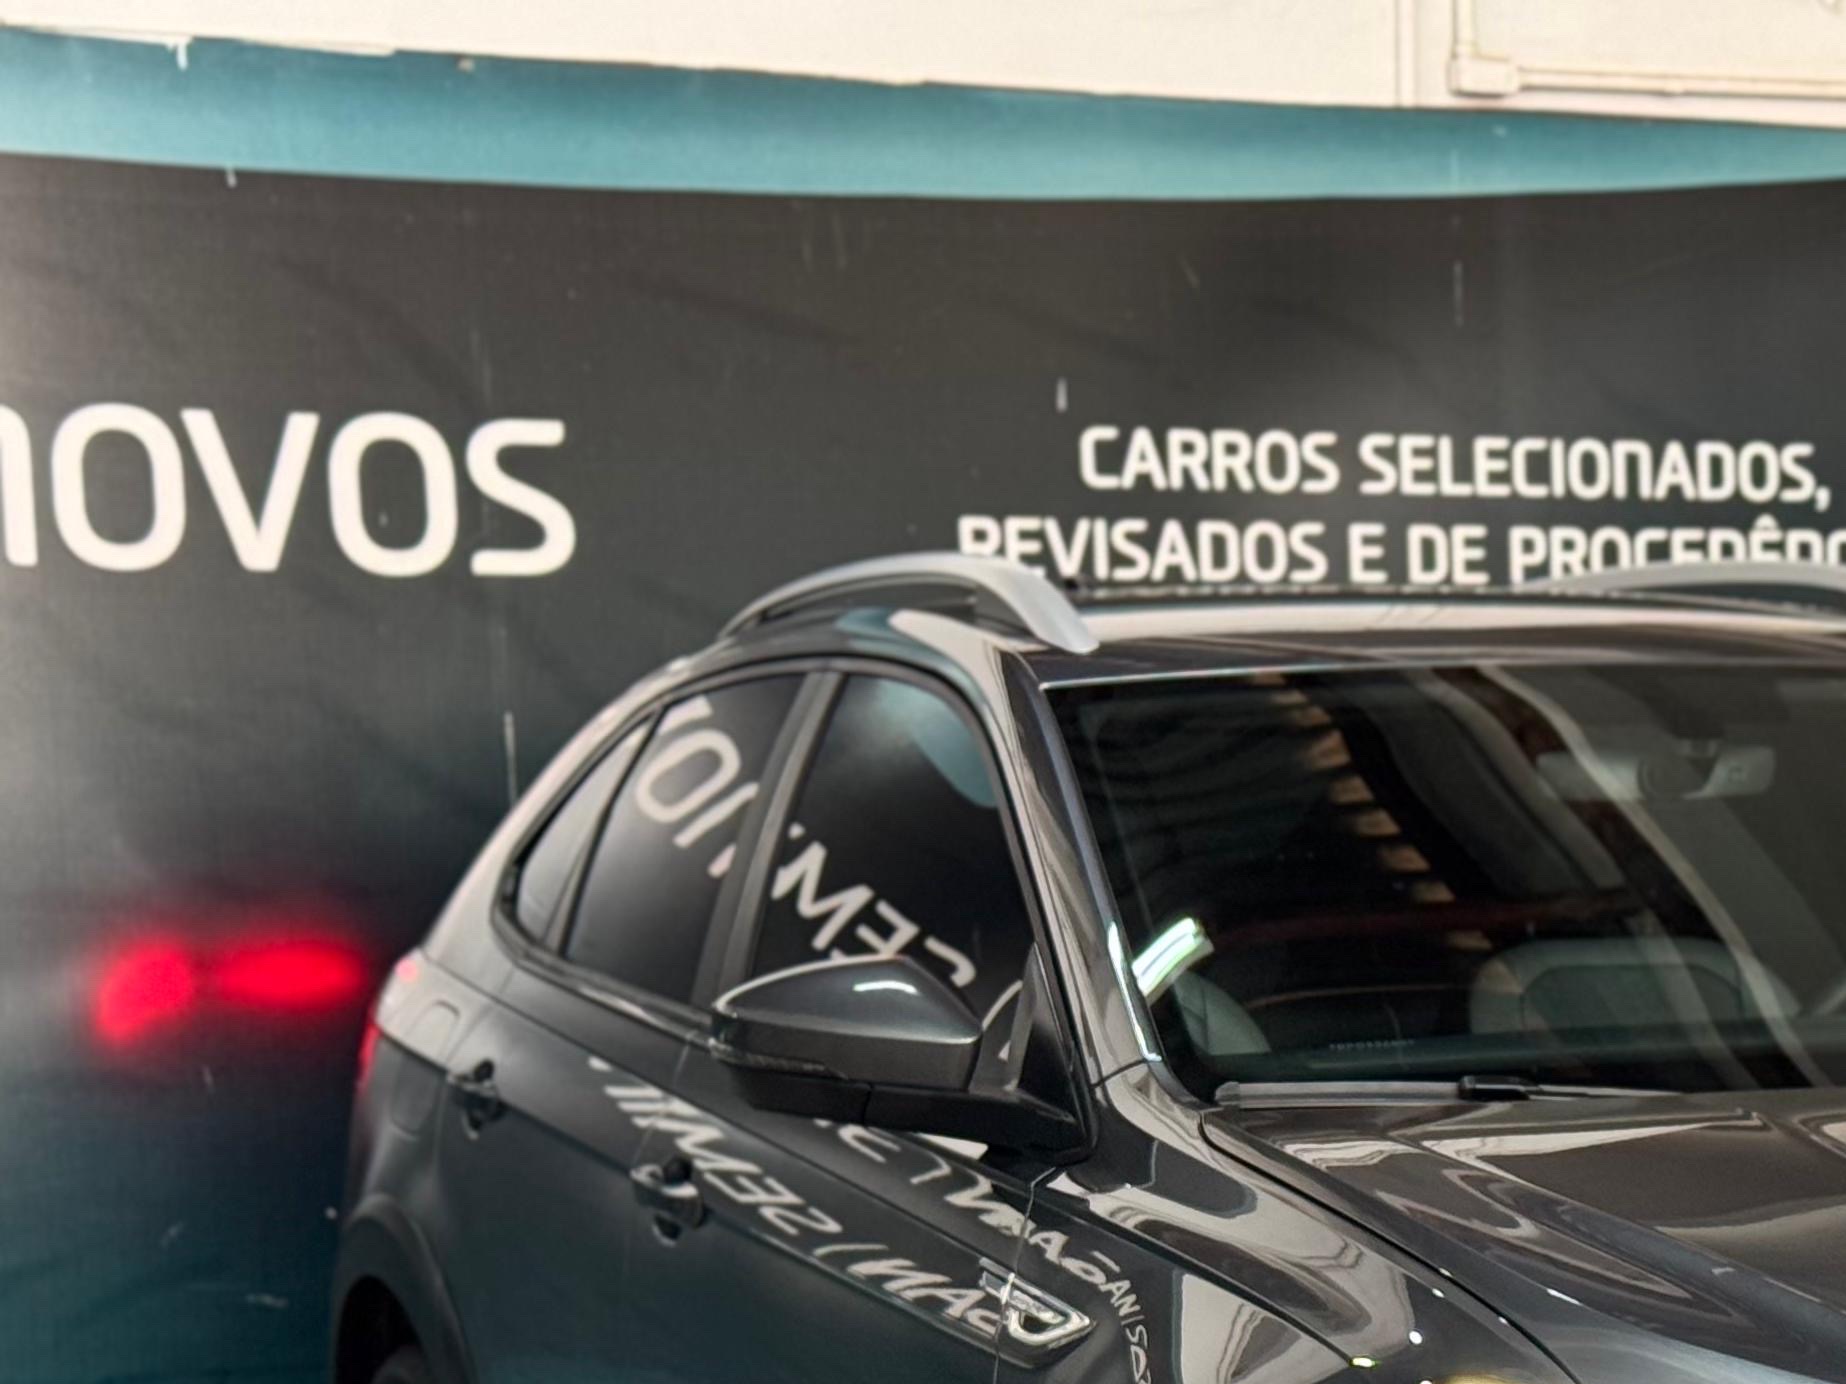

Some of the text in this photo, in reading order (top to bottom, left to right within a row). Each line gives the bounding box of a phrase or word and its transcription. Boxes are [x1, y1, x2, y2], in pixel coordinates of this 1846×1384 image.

[1079, 425, 1831, 512] CARROS SELECIONADOS,
[957, 515, 1329, 583] REVISADOS
[1348, 522, 1387, 584] E
[1408, 524, 1490, 586] DE
